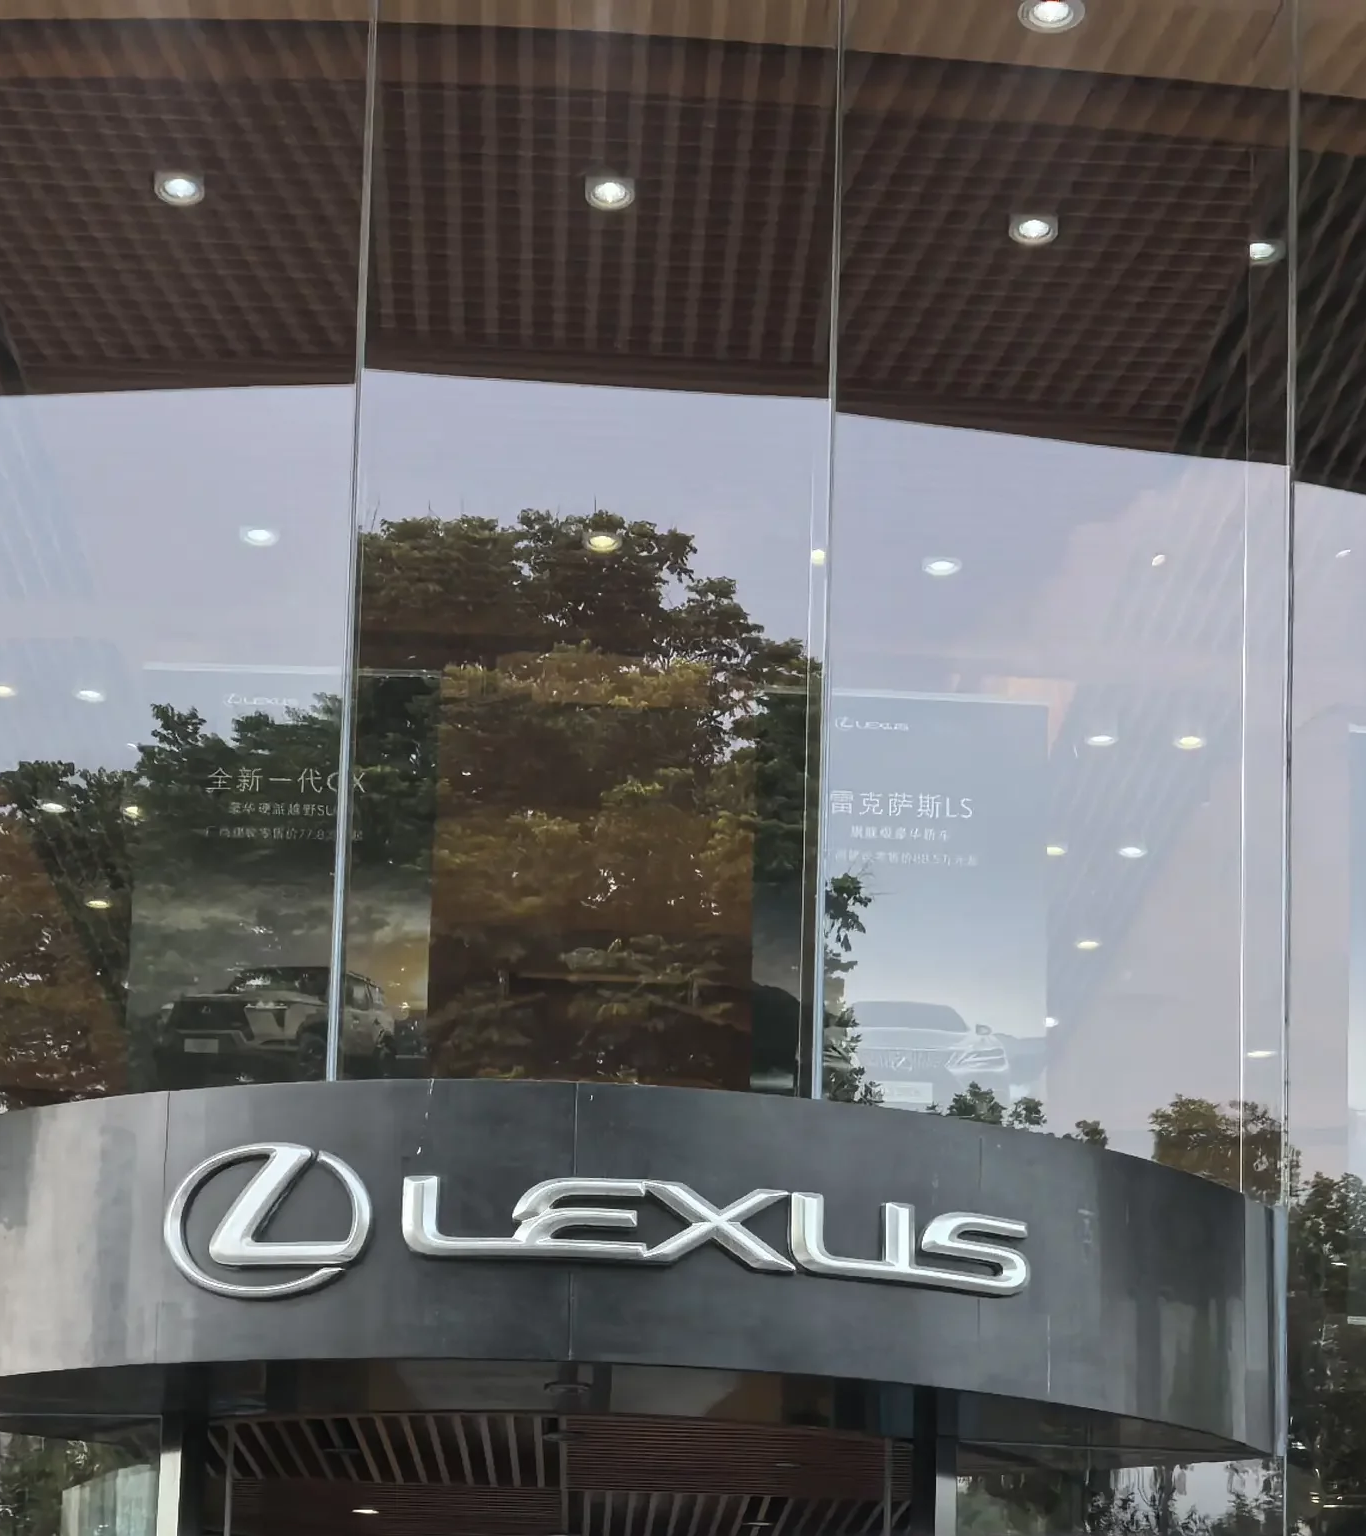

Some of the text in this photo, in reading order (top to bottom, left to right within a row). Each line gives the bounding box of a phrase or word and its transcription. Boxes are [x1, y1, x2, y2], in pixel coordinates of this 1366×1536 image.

[830, 789, 975, 820] 雷克萨斯LS
[402, 1174, 1032, 1298] LEXUS
